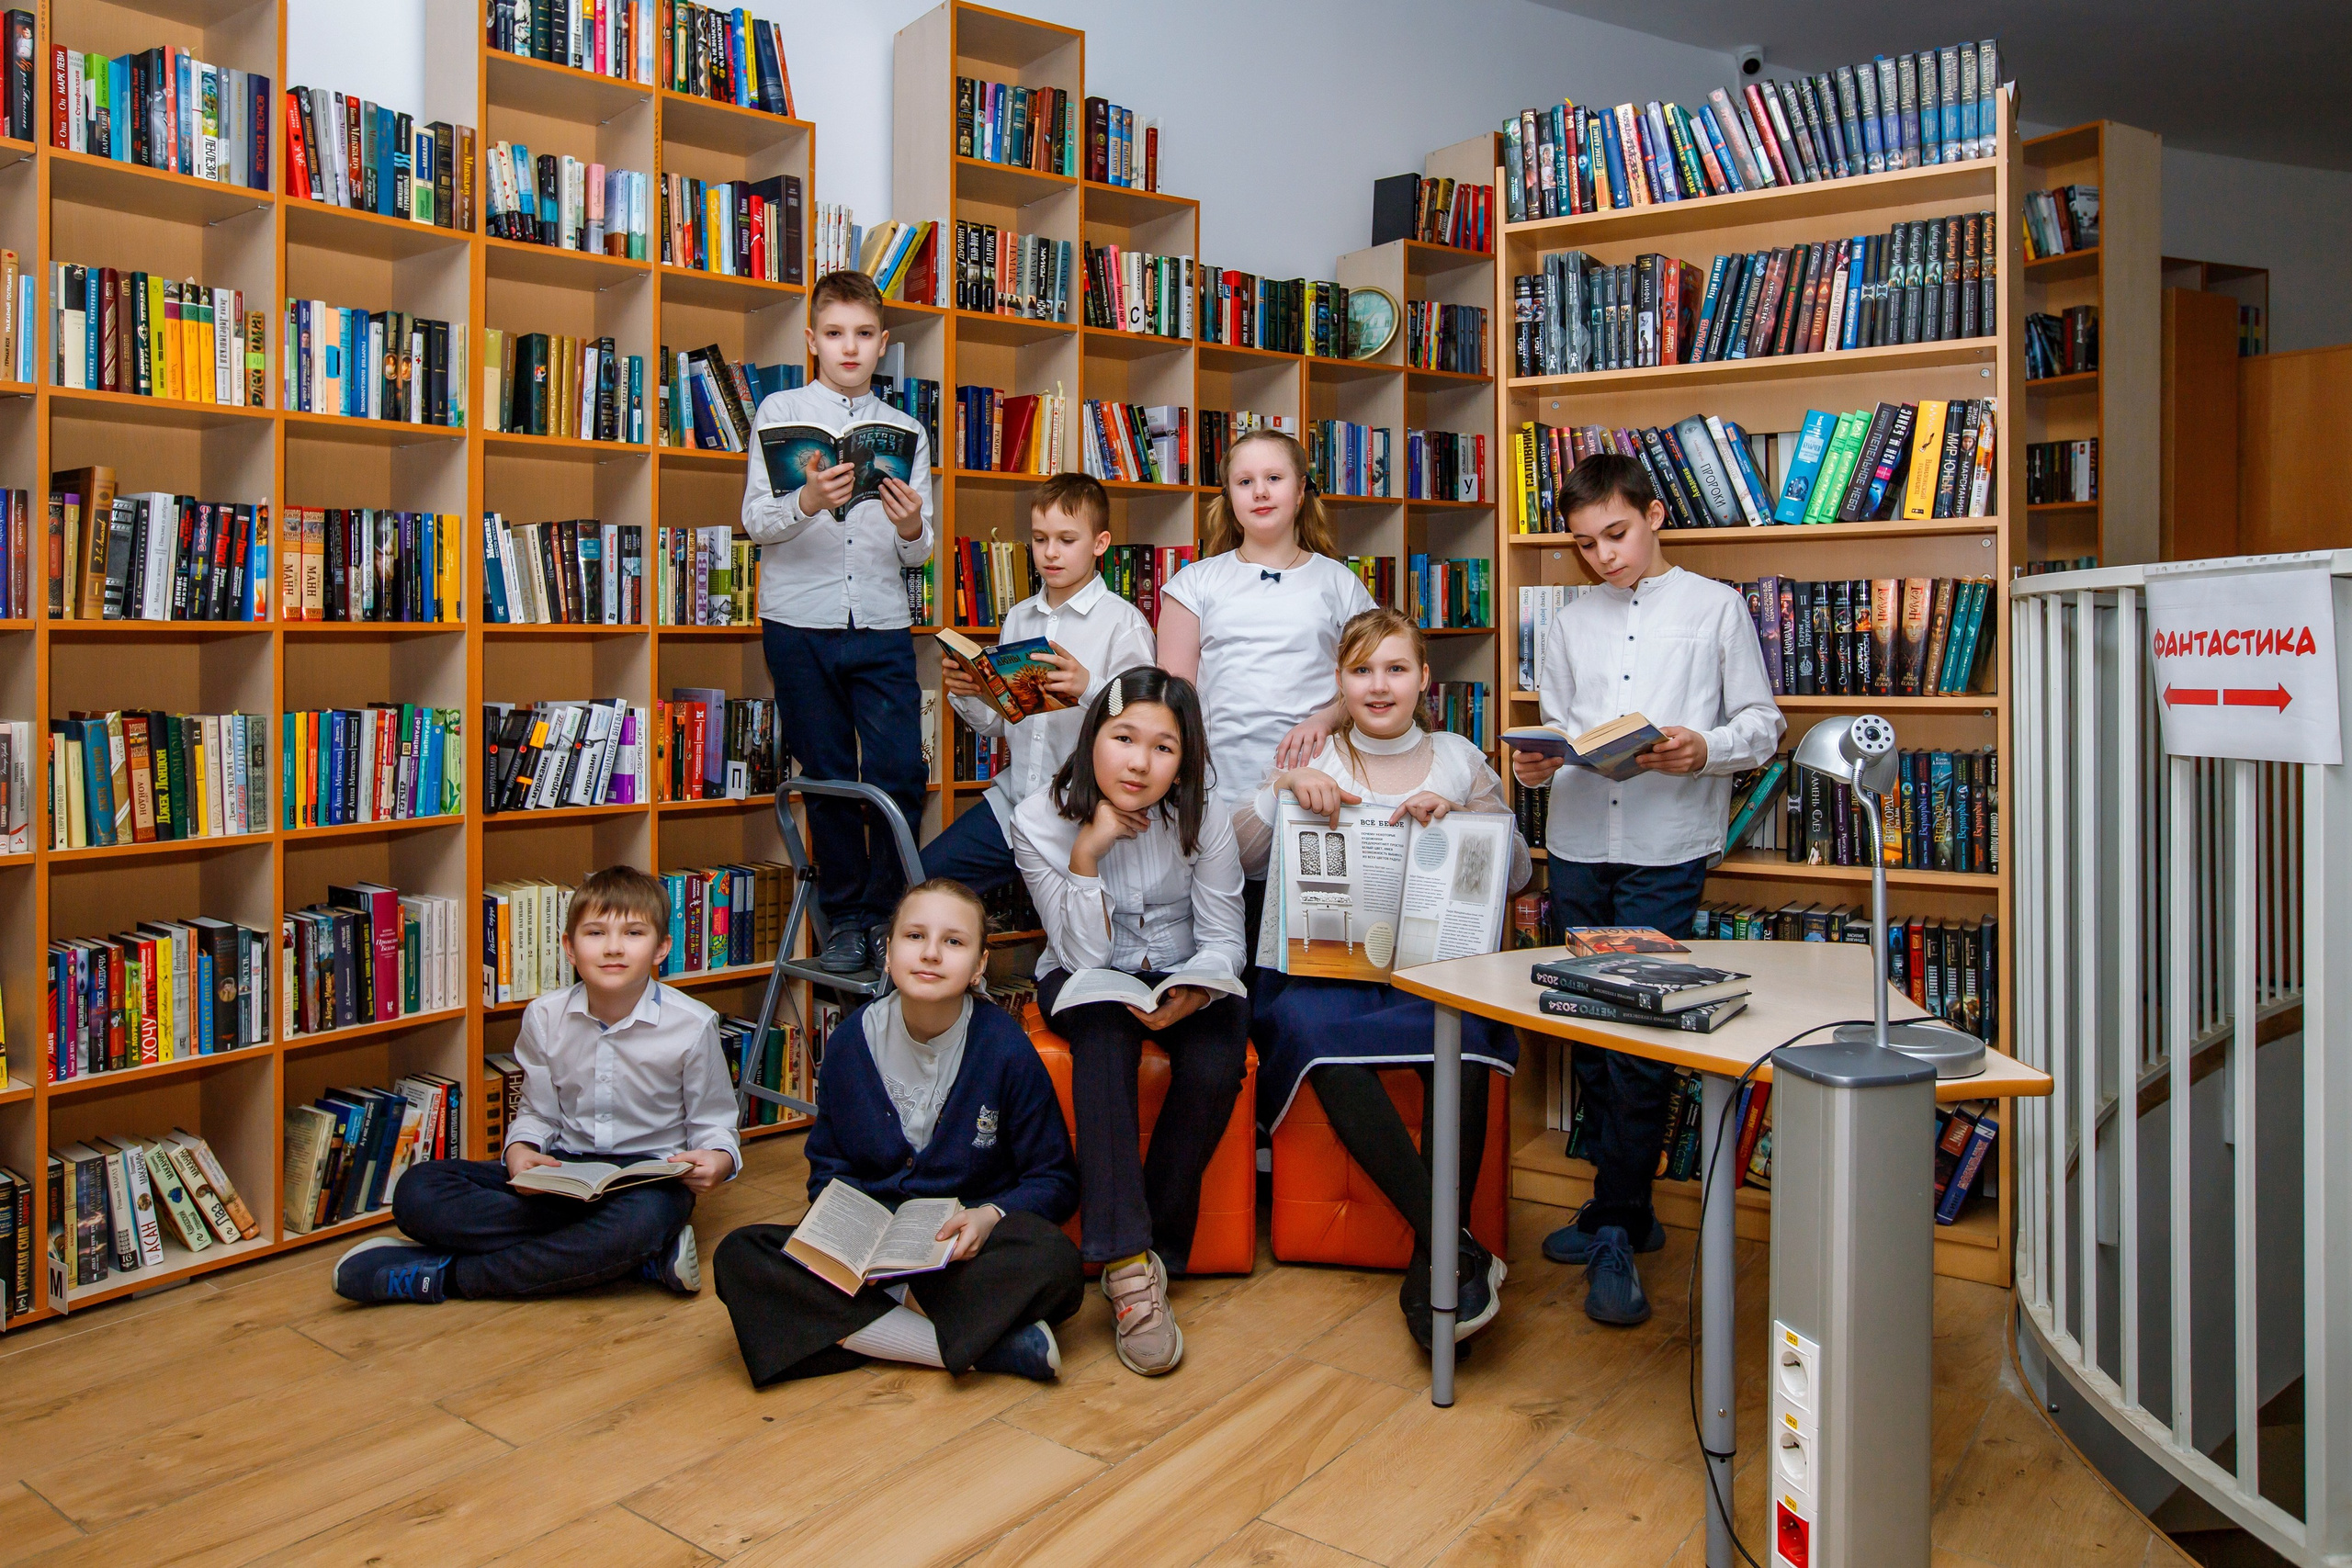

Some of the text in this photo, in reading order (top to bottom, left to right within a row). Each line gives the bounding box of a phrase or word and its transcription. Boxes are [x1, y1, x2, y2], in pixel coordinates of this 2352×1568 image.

[55, 51, 65, 95] МАРК ЛЕВИ
[256, 96, 265, 173] ЛЕОНИД ЛЕОНОВ
[1647, 161, 1661, 199] АЙЗЕК АЗИМОВ
[970, 231, 978, 261] НЬЮ-ЙОРК
[1691, 319, 1710, 362] КИР БУЛЫЧЕВ
[1521, 426, 1534, 487] САДОВНИК
[1881, 409, 1913, 466] ИЭН БЭНКС
[1539, 443, 1547, 479] ИЩЕЙКА
[1940, 433, 1959, 494] МИР ЮНЫХ
[1700, 463, 1726, 508] ПРОРОКИ
[1955, 461, 1970, 514] МАРСИАНИН
[484, 518, 495, 559] Москва:
[697, 558, 707, 623] ОРЛОВ
[2154, 626, 2316, 660] ФАНТАСТИКА
[155, 750, 171, 824] Джек Лондон
[334, 751, 343, 807] Анна Матвеева
[348, 751, 356, 786] Матвеева
[530, 756, 549, 799] мураками
[549, 755, 566, 797] мураками
[582, 753, 597, 796] мураками
[1535, 972, 1589, 993] МЕТРО 2034
[142, 980, 157, 1061] ХОЧУ ЖИТЬ!
[1548, 999, 1617, 1019] МЕТРО 2034
[141, 1220, 161, 1252] АСАН
[210, 1202, 230, 1227] Лаз
[50, 1268, 62, 1299] М
